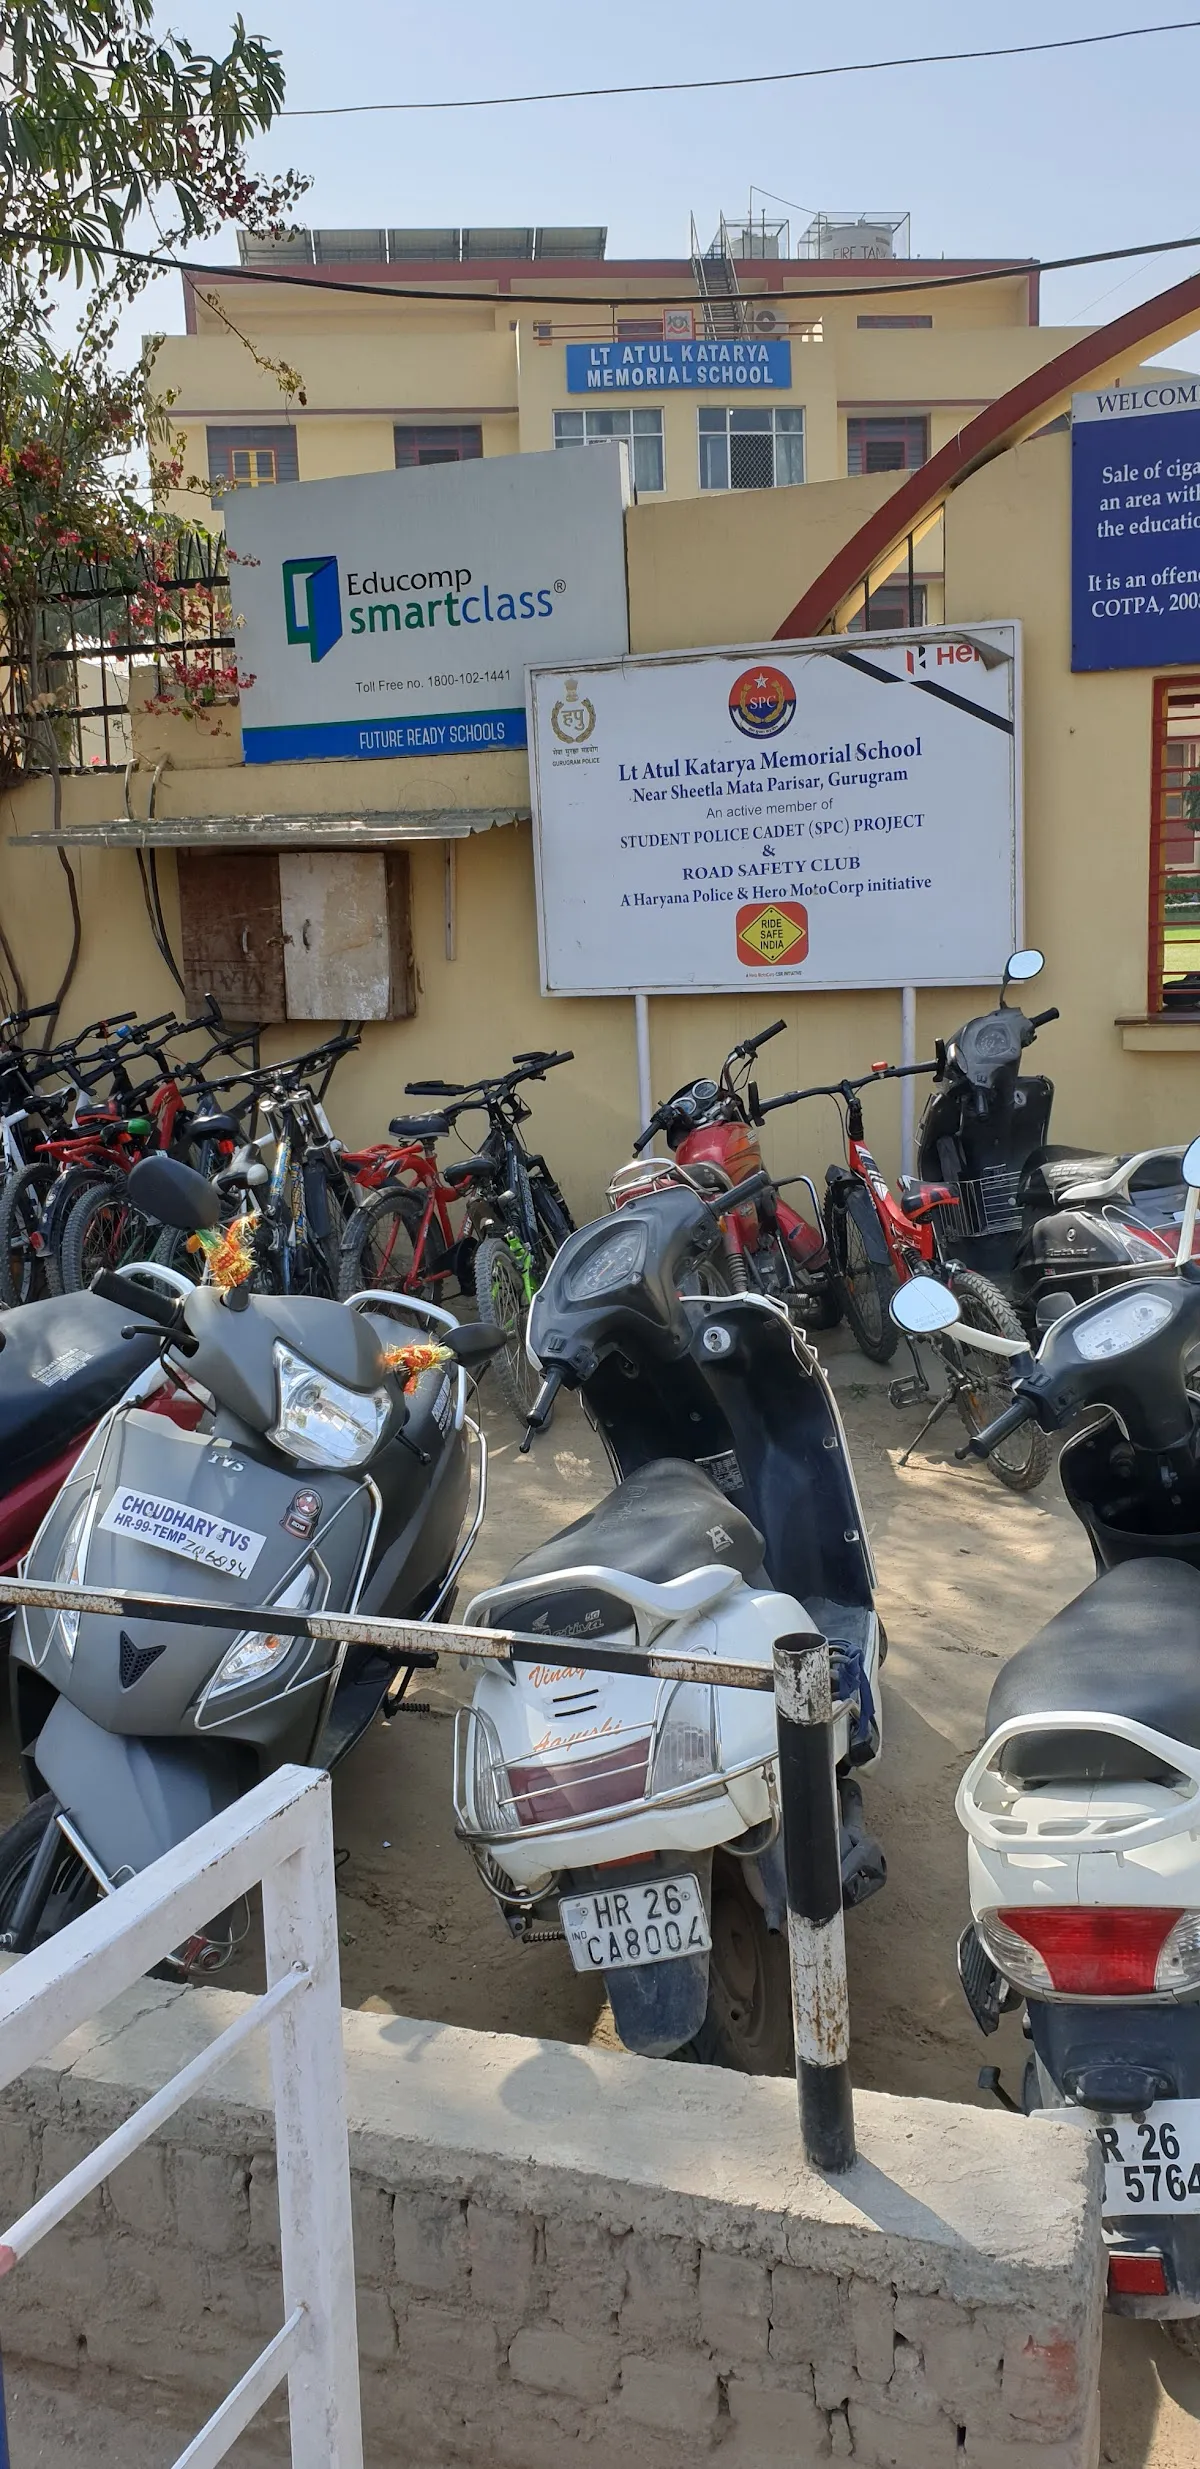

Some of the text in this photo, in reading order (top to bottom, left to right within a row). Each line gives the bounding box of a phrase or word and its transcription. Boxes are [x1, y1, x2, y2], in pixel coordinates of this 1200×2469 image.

[590, 344, 770, 366] LT ATUL KATARYA
[587, 365, 774, 388] MEMORIAL SCHOOL
[1096, 384, 1200, 413] WELCOM
[1102, 463, 1139, 484] Sale
[1143, 460, 1163, 480] of
[1099, 497, 1121, 512] an
[1125, 492, 1161, 509] area
[1097, 519, 1125, 538] the
[346, 568, 472, 597] Educomp
[1088, 574, 1102, 592] It
[1106, 572, 1121, 591] is
[1125, 573, 1147, 589] an
[1091, 595, 1165, 618] COTPA,
[355, 669, 511, 694] Toll Free no. 1800-102-1441
[749, 695, 776, 710] SPC
[359, 722, 506, 750] FUTURE READY SCHOOLS
[552, 757, 600, 767] GURUGRAM POLICE
[618, 737, 923, 782] Lt Atul Katarya Memorial School
[632, 767, 909, 803] Near Sheetla Mata Parisar, Gurugram
[706, 798, 834, 819] An active member of
[620, 813, 926, 849] STUDENT POLICE CADET (SPC) PROJECT
[762, 844, 776, 857] &
[682, 856, 861, 881] ROAD SAFETY CLUB
[620, 875, 932, 909] A Haryana Police & Hero MotoCorp initiative
[760, 929, 784, 940] SAFE
[761, 918, 782, 929] RIDE
[760, 940, 784, 951] INDIA
[207, 1451, 248, 1473] TVS
[113, 1512, 188, 1545] HR-99-TEMP
[121, 1495, 251, 1552] CHOUDHARY TVS
[593, 1884, 683, 1929] HR 26
[571, 1930, 588, 1942] IND
[587, 1915, 704, 1965] CA8004
[1137, 2122, 1181, 2161] 26
[1123, 2162, 1200, 2203] 5764
